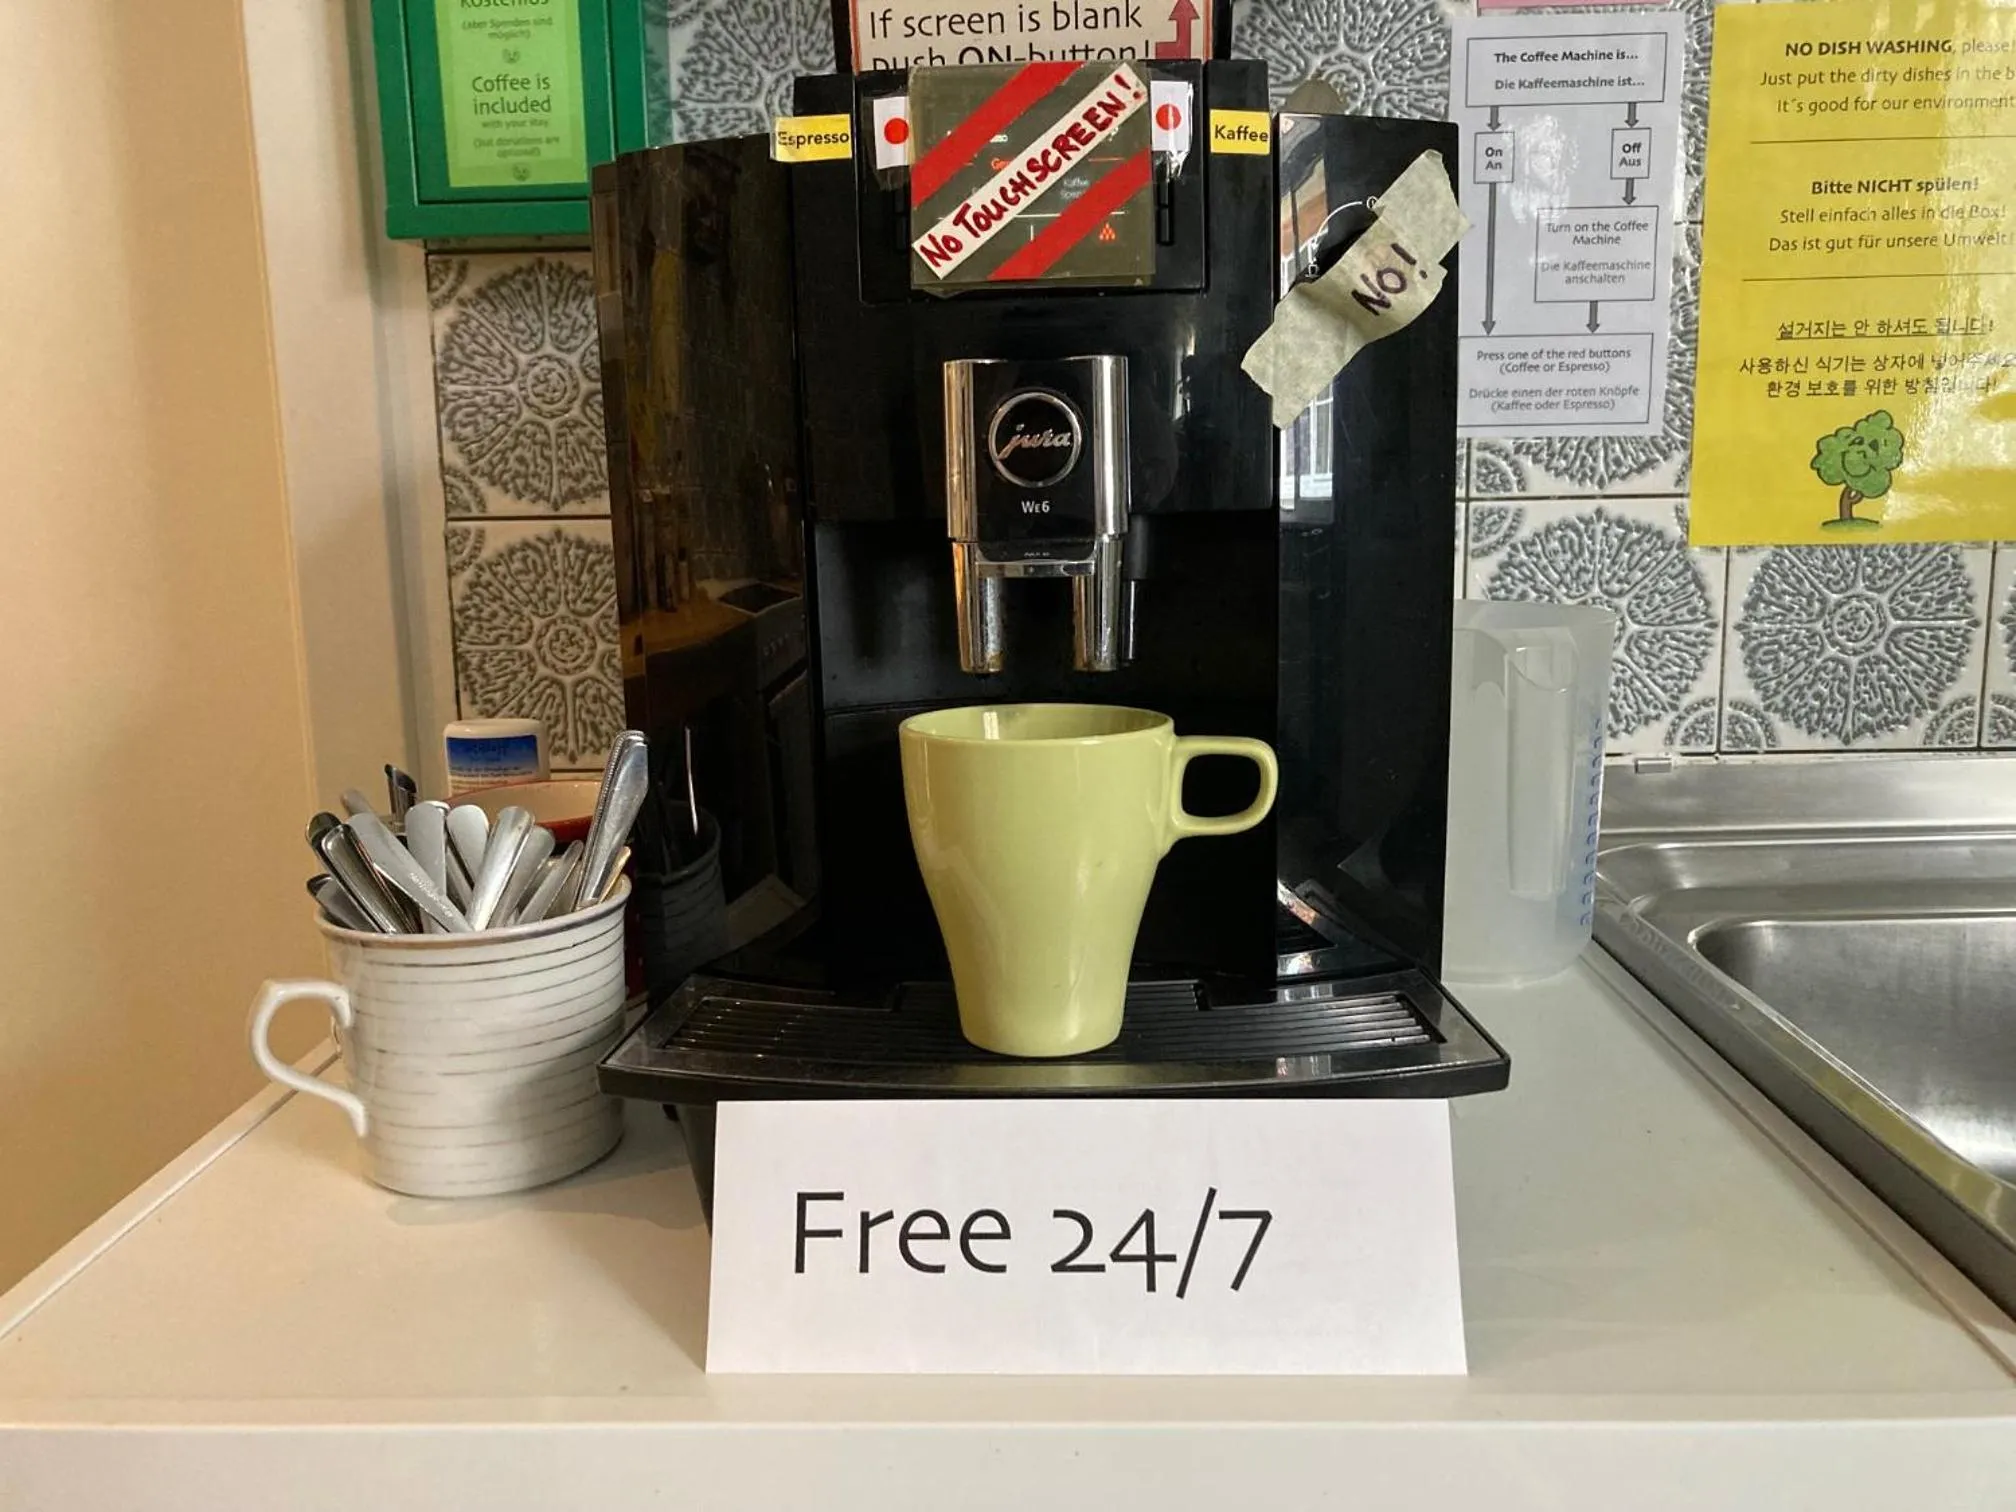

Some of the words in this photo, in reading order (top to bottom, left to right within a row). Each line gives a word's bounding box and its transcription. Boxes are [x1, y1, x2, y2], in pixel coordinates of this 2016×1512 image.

[871, 8, 892, 39] If
[904, 11, 1005, 38] screen
[1018, 4, 1041, 33] is
[1053, 0, 1142, 31] blank
[1494, 53, 1517, 63] The
[1520, 52, 1559, 63] Coffee
[1561, 51, 1614, 61] Machine
[1616, 50, 1639, 60] is...
[1785, 43, 1812, 56] NO
[1818, 41, 1860, 56] DISH
[1866, 40, 1956, 55] WASHING,
[472, 74, 531, 92] Coffee
[537, 73, 550, 90] is
[1495, 79, 1515, 90] Die
[1518, 77, 1614, 90] Kaffeemaschine
[1617, 77, 1645, 87] ist...
[1760, 71, 1792, 86] Just
[1797, 71, 1824, 88] put
[1830, 69, 1856, 83] the
[1861, 67, 1898, 85] dirty
[1903, 67, 1951, 82] dishes
[1956, 67, 1970, 80] in
[1976, 66, 2002, 80] the
[473, 95, 551, 115] included
[1808, 97, 1849, 116] good
[1854, 96, 1877, 111] for
[1882, 98, 1908, 110] our
[778, 131, 850, 149] Espresso
[1215, 124, 1268, 142] Kaffee
[1485, 147, 1503, 157] On
[1622, 142, 1641, 154] Off
[1485, 161, 1502, 170] An
[1619, 157, 1641, 167] Aus
[1811, 180, 1852, 195] Bitte
[1857, 179, 1912, 194] NICHT
[1916, 177, 1979, 195] spülen!
[1780, 208, 1814, 223] Stell
[1819, 207, 1877, 222] einfach
[1881, 206, 1916, 220] alles
[1921, 205, 1935, 219] in
[1940, 205, 1964, 219] die
[1969, 204, 2006, 219] Box!
[1547, 222, 1571, 233] Turn
[1574, 223, 1588, 232] on
[1591, 221, 1610, 231] the
[1614, 220, 1648, 231] Coffee
[1572, 235, 1621, 245] Machine
[1769, 237, 1798, 251] Das
[1803, 236, 1820, 250] ist
[1826, 236, 1852, 253] gut
[1858, 234, 1879, 249] für
[1886, 235, 1938, 248] unsere
[1541, 262, 1560, 272] Die
[1563, 260, 1651, 271] Kaffeemaschine
[1565, 274, 1626, 284] anschalten
[1777, 320, 1846, 339] 설거지는
[1854, 318, 1869, 336] 안
[1877, 317, 1928, 335] 하셔도
[1477, 350, 1505, 360] Press
[1508, 351, 1528, 360] one
[1531, 350, 1545, 359] of
[1547, 349, 1564, 359] the
[1567, 349, 1586, 359] red
[1589, 348, 1631, 358] buttons
[1499, 362, 1540, 375] (Coffee
[1543, 364, 1555, 372] or
[1558, 361, 1610, 374] Espresso)
[1739, 356, 1809, 375] 사용하신
[1816, 355, 1866, 373] 식기는
[1873, 353, 1924, 371] 상자에
[1469, 388, 1508, 399] Drücke
[1511, 388, 1543, 397] einen
[1545, 387, 1563, 397] der
[1566, 387, 1596, 397] roten
[1599, 386, 1640, 399] Knöpfe
[1767, 379, 1801, 398] 환경
[1806, 378, 1858, 397] 보호를
[1865, 377, 1898, 396] 위한
[1491, 400, 1531, 412] (Kaffee
[1534, 400, 1560, 410] oder
[1563, 399, 1616, 412] Espresso)
[997, 424, 1072, 460] jura
[794, 1191, 1012, 1274] Free
[1050, 1187, 1273, 1299] 24/7
